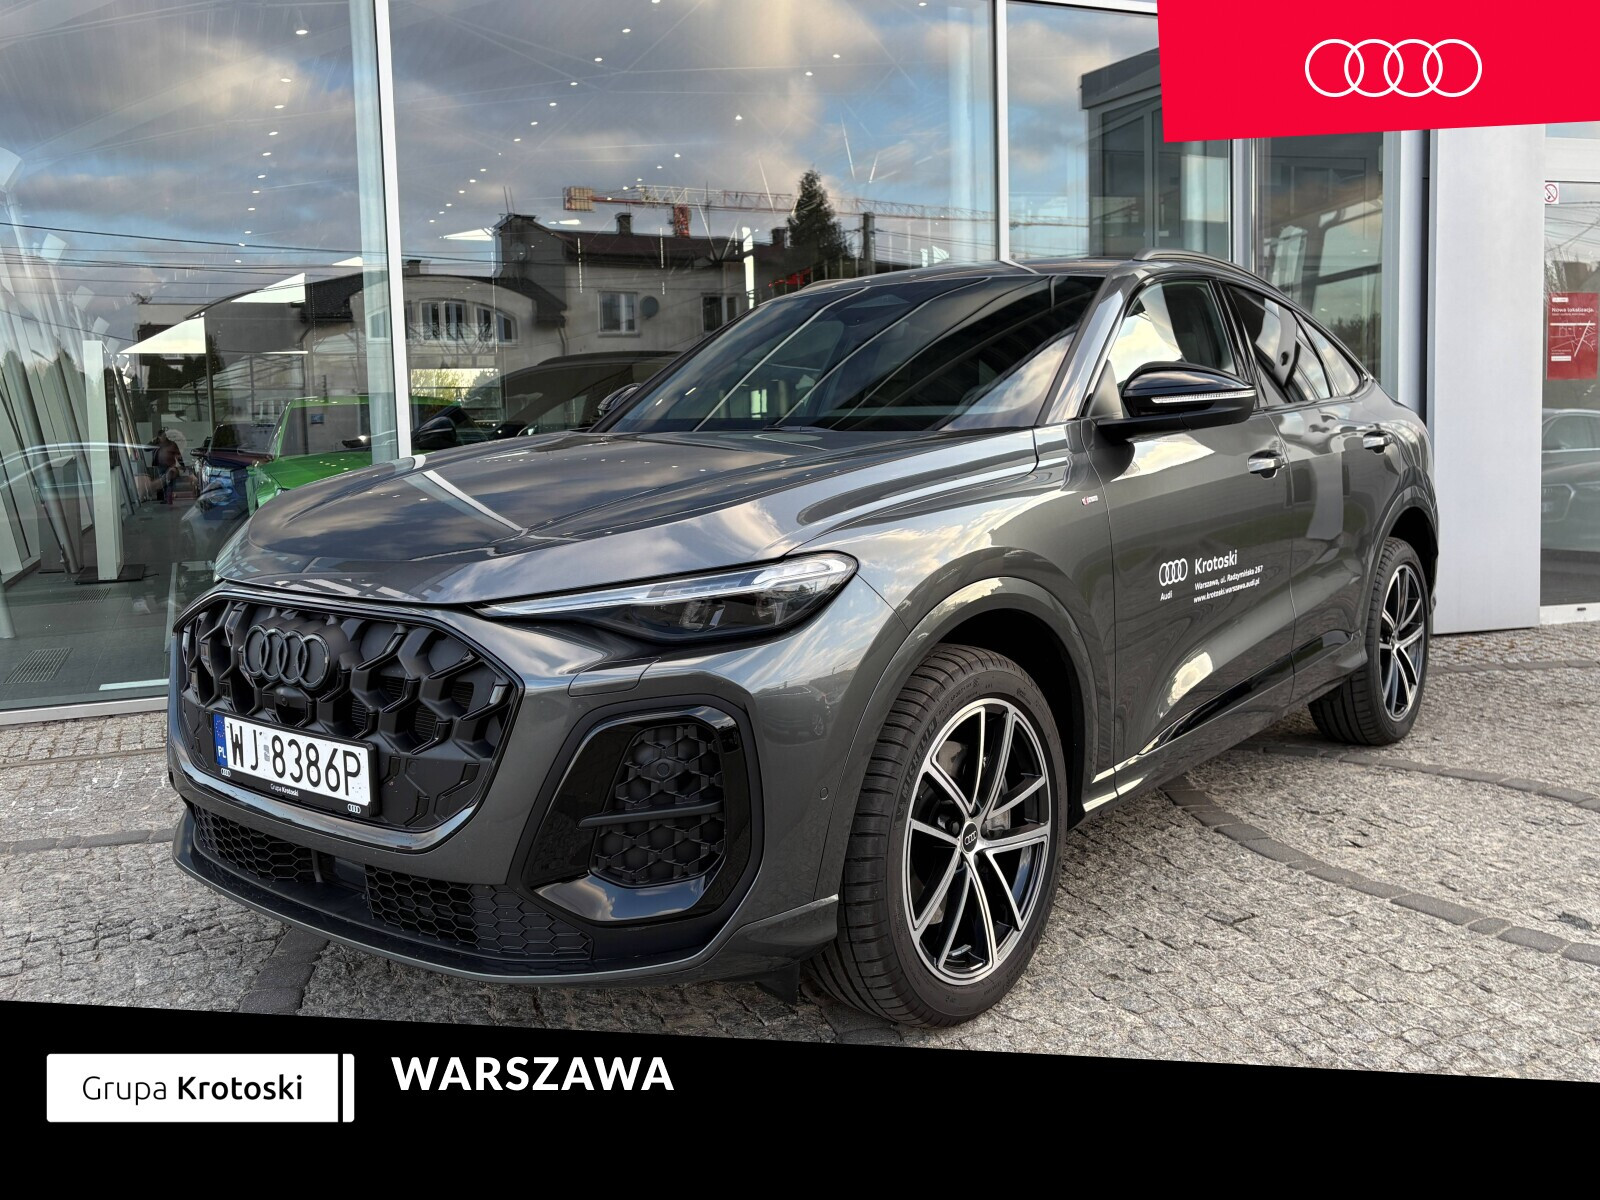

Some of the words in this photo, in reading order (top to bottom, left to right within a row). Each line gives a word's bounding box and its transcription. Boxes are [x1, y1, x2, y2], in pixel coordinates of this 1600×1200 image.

[1195, 549, 1238, 575] Krotoski
[1194, 578, 1220, 591] Warszawa,
[1160, 590, 1173, 601] Audi
[217, 746, 227, 759] PL
[229, 722, 259, 771] WJ
[271, 734, 361, 796] 8386P
[901, 716, 938, 798] MICHELIN
[270, 783, 282, 793] Grupa
[282, 786, 299, 797] Krotoski
